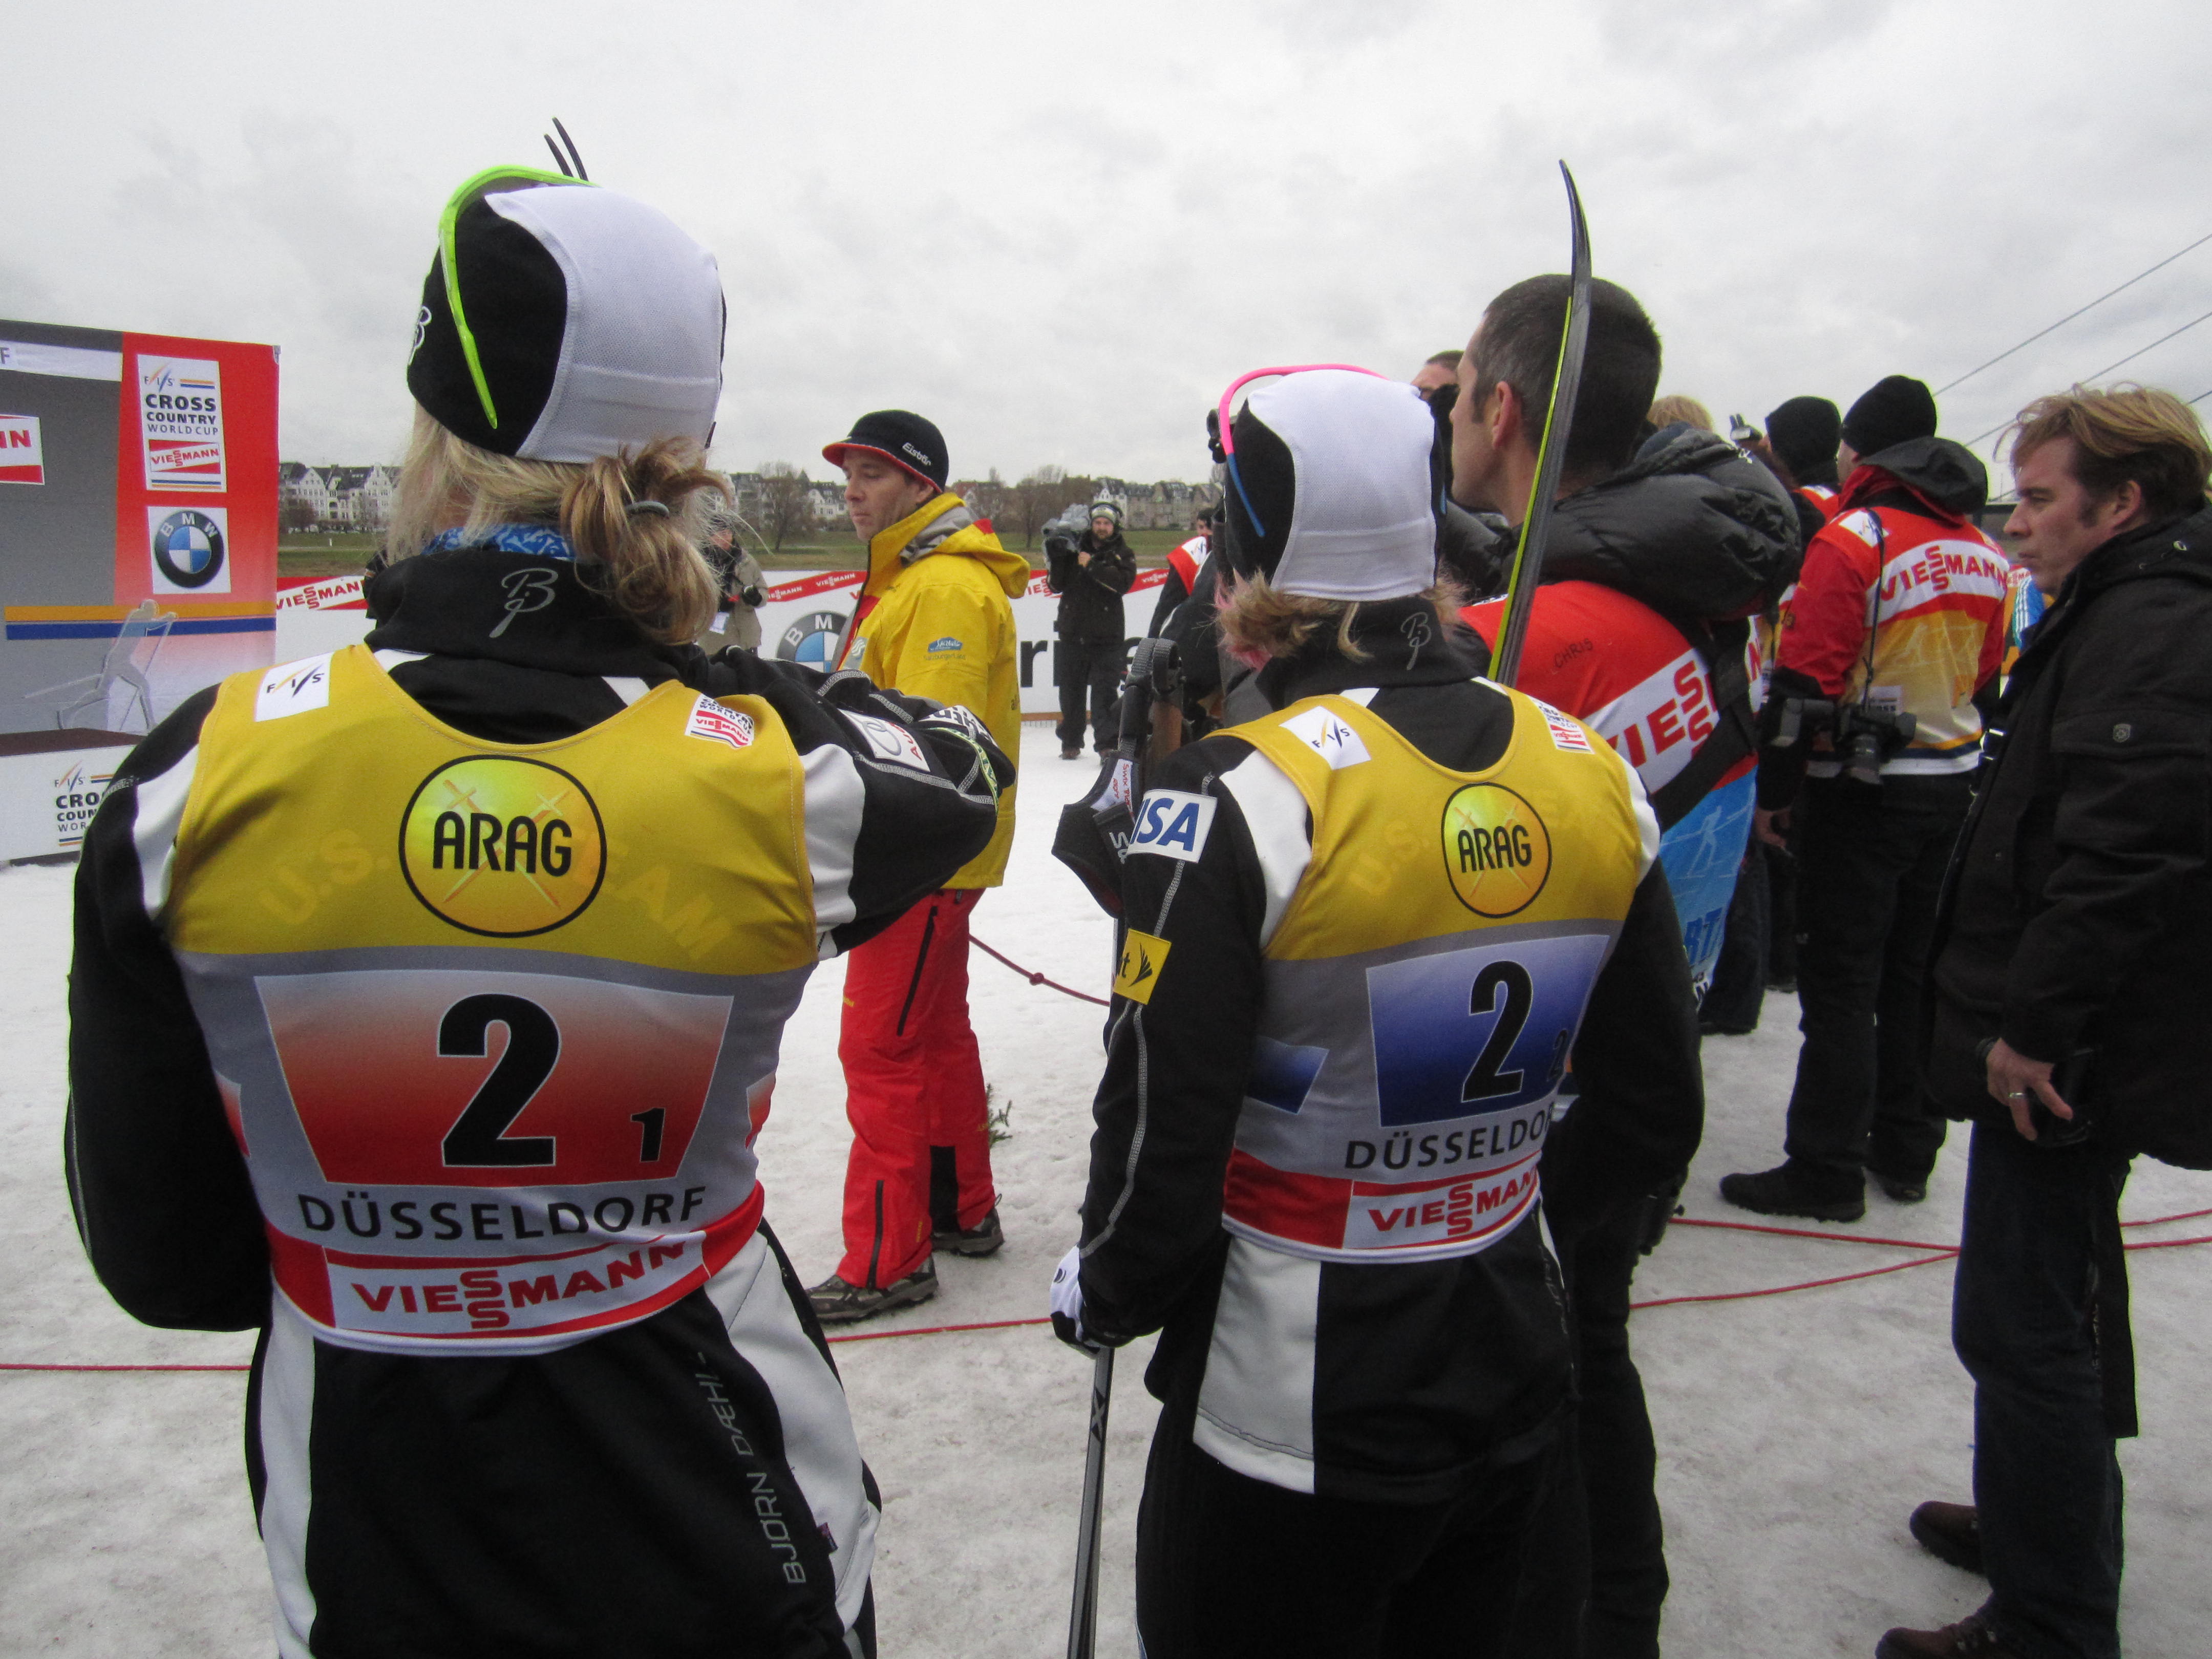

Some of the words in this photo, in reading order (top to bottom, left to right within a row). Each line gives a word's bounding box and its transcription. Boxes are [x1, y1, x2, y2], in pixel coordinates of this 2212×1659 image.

[145, 394, 216, 412] CROSS
[146, 412, 216, 425] COUNTRY
[147, 424, 192, 434] WORLD
[196, 426, 219, 435] CUP
[151, 449, 219, 466] VIESSMANN
[162, 513, 217, 537] BMW
[1880, 545, 2007, 601] VIESSMANN
[768, 586, 802, 600] IESSMANN
[784, 614, 833, 647] BM
[1554, 638, 1593, 668] CHRIS
[267, 672, 325, 693] FIS
[56, 792, 100, 809] CRO
[57, 809, 97, 821] COUN
[58, 822, 87, 832] WOR
[432, 810, 572, 877] ARAG
[1458, 824, 1533, 874] ARAG
[1461, 960, 1534, 1104] 2
[437, 992, 562, 1167] 2
[631, 1107, 666, 1163] 1
[297, 1186, 707, 1241] DÜSSELDORF
[351, 1242, 686, 1329] VIESSMANN
